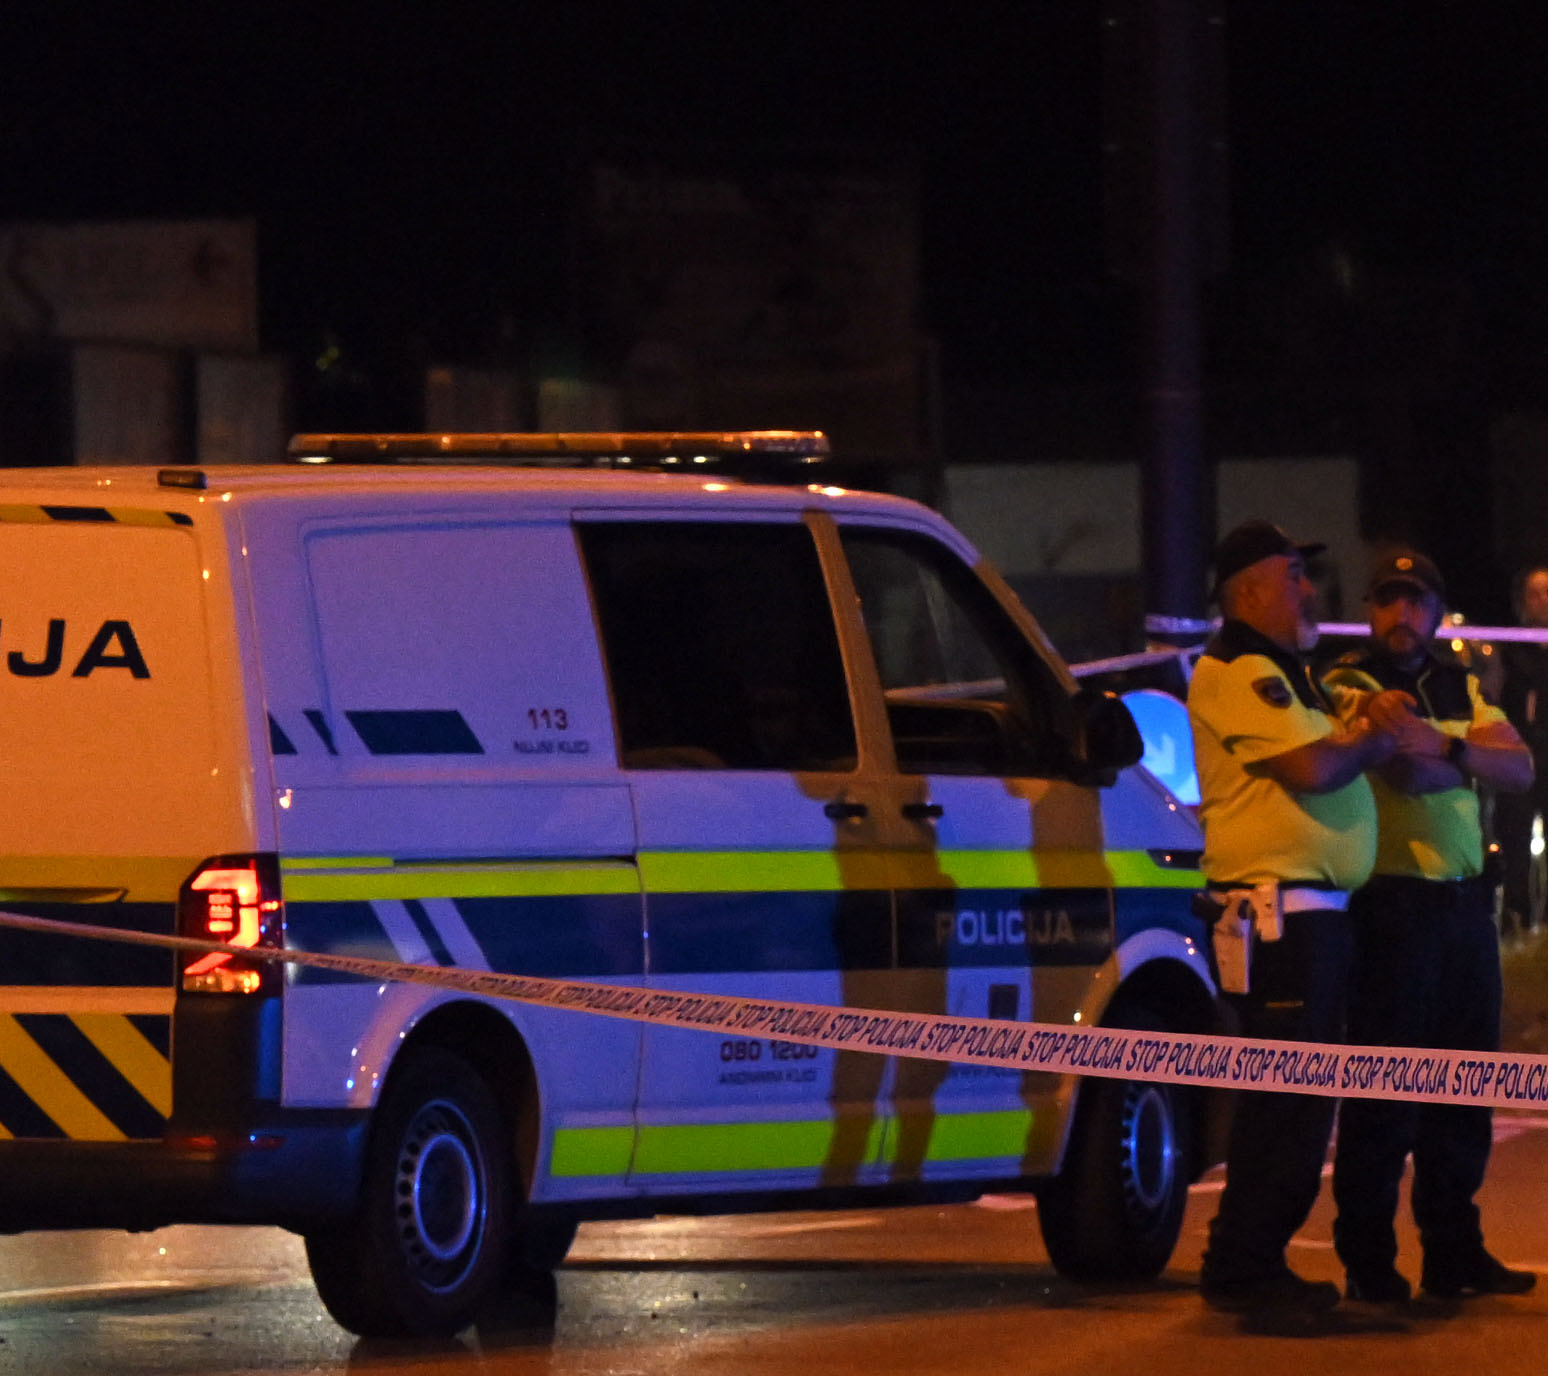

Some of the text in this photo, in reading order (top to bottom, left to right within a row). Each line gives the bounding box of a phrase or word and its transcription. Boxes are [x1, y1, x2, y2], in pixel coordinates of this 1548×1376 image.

[527, 708, 568, 731] 113
[936, 909, 1076, 945] POLICIJA
[726, 1004, 767, 1029] STOP
[767, 1008, 826, 1037] POLICIJA
[822, 1014, 864, 1041] STOP
[860, 1017, 928, 1049] POLICIJA
[921, 1022, 966, 1052] STOP
[959, 1026, 1026, 1060] POLICIJA
[1022, 1030, 1064, 1061] STOP
[1061, 1034, 1129, 1070] POLICIJA
[1125, 1039, 1170, 1072] STOP
[1166, 1042, 1234, 1079] POLICIJA
[1232, 1047, 1275, 1081] STOP
[1272, 1050, 1340, 1088] POLICIJA
[1341, 1054, 1384, 1090] STOP
[1382, 1057, 1451, 1094] POLICIJA
[1452, 1061, 1496, 1097] STOP
